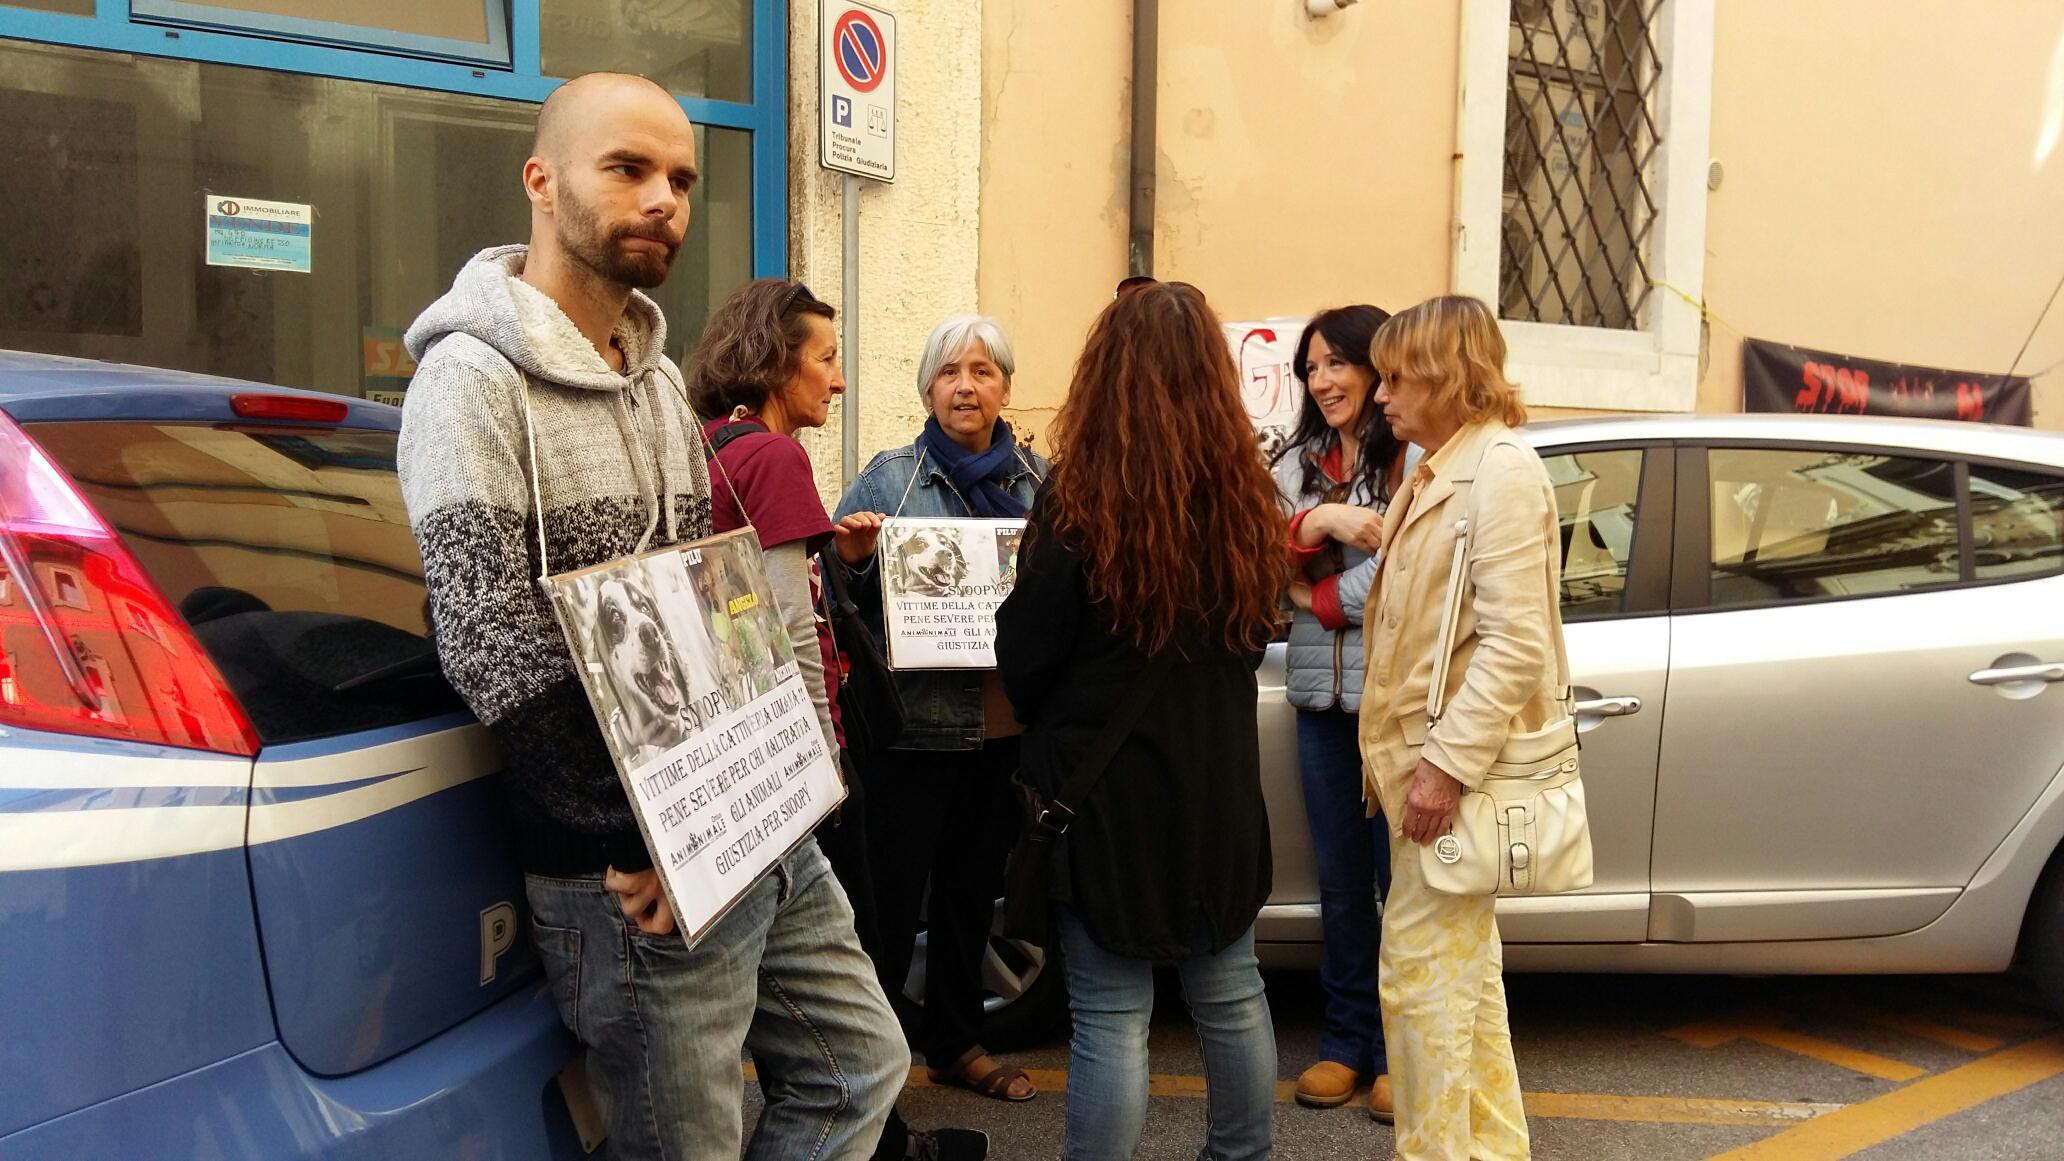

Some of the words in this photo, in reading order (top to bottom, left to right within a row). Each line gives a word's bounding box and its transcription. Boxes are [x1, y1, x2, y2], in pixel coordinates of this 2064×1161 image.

[837, 99, 849, 122] P
[832, 131, 861, 146] Tribunale
[832, 141, 856, 154] Procura
[832, 151, 853, 162] Polizia
[856, 157, 888, 171] Giudiziaria
[243, 205, 302, 217] IMMOBILIARE
[948, 585, 1000, 596] SNOOPY
[897, 602, 939, 610] VITTIME
[941, 602, 975, 610] DELLA
[904, 615, 931, 624] PENE
[933, 614, 974, 623] SEVERE
[964, 628, 981, 637] GLI
[937, 642, 990, 650] GIUSTIZIA
[639, 759, 688, 801] VITTIME
[688, 739, 723, 772] DELLA
[658, 793, 693, 833] PENE
[690, 770, 732, 812] SEVERE
[729, 757, 751, 791] PER
[749, 747, 766, 774] CHI
[730, 797, 748, 823] GLI
[746, 771, 783, 814] ANIMALI
[715, 824, 766, 876] GIUSTIZIA
[761, 809, 783, 838] PER
[779, 781, 815, 823] SNOOPY
[480, 901, 517, 987] P
